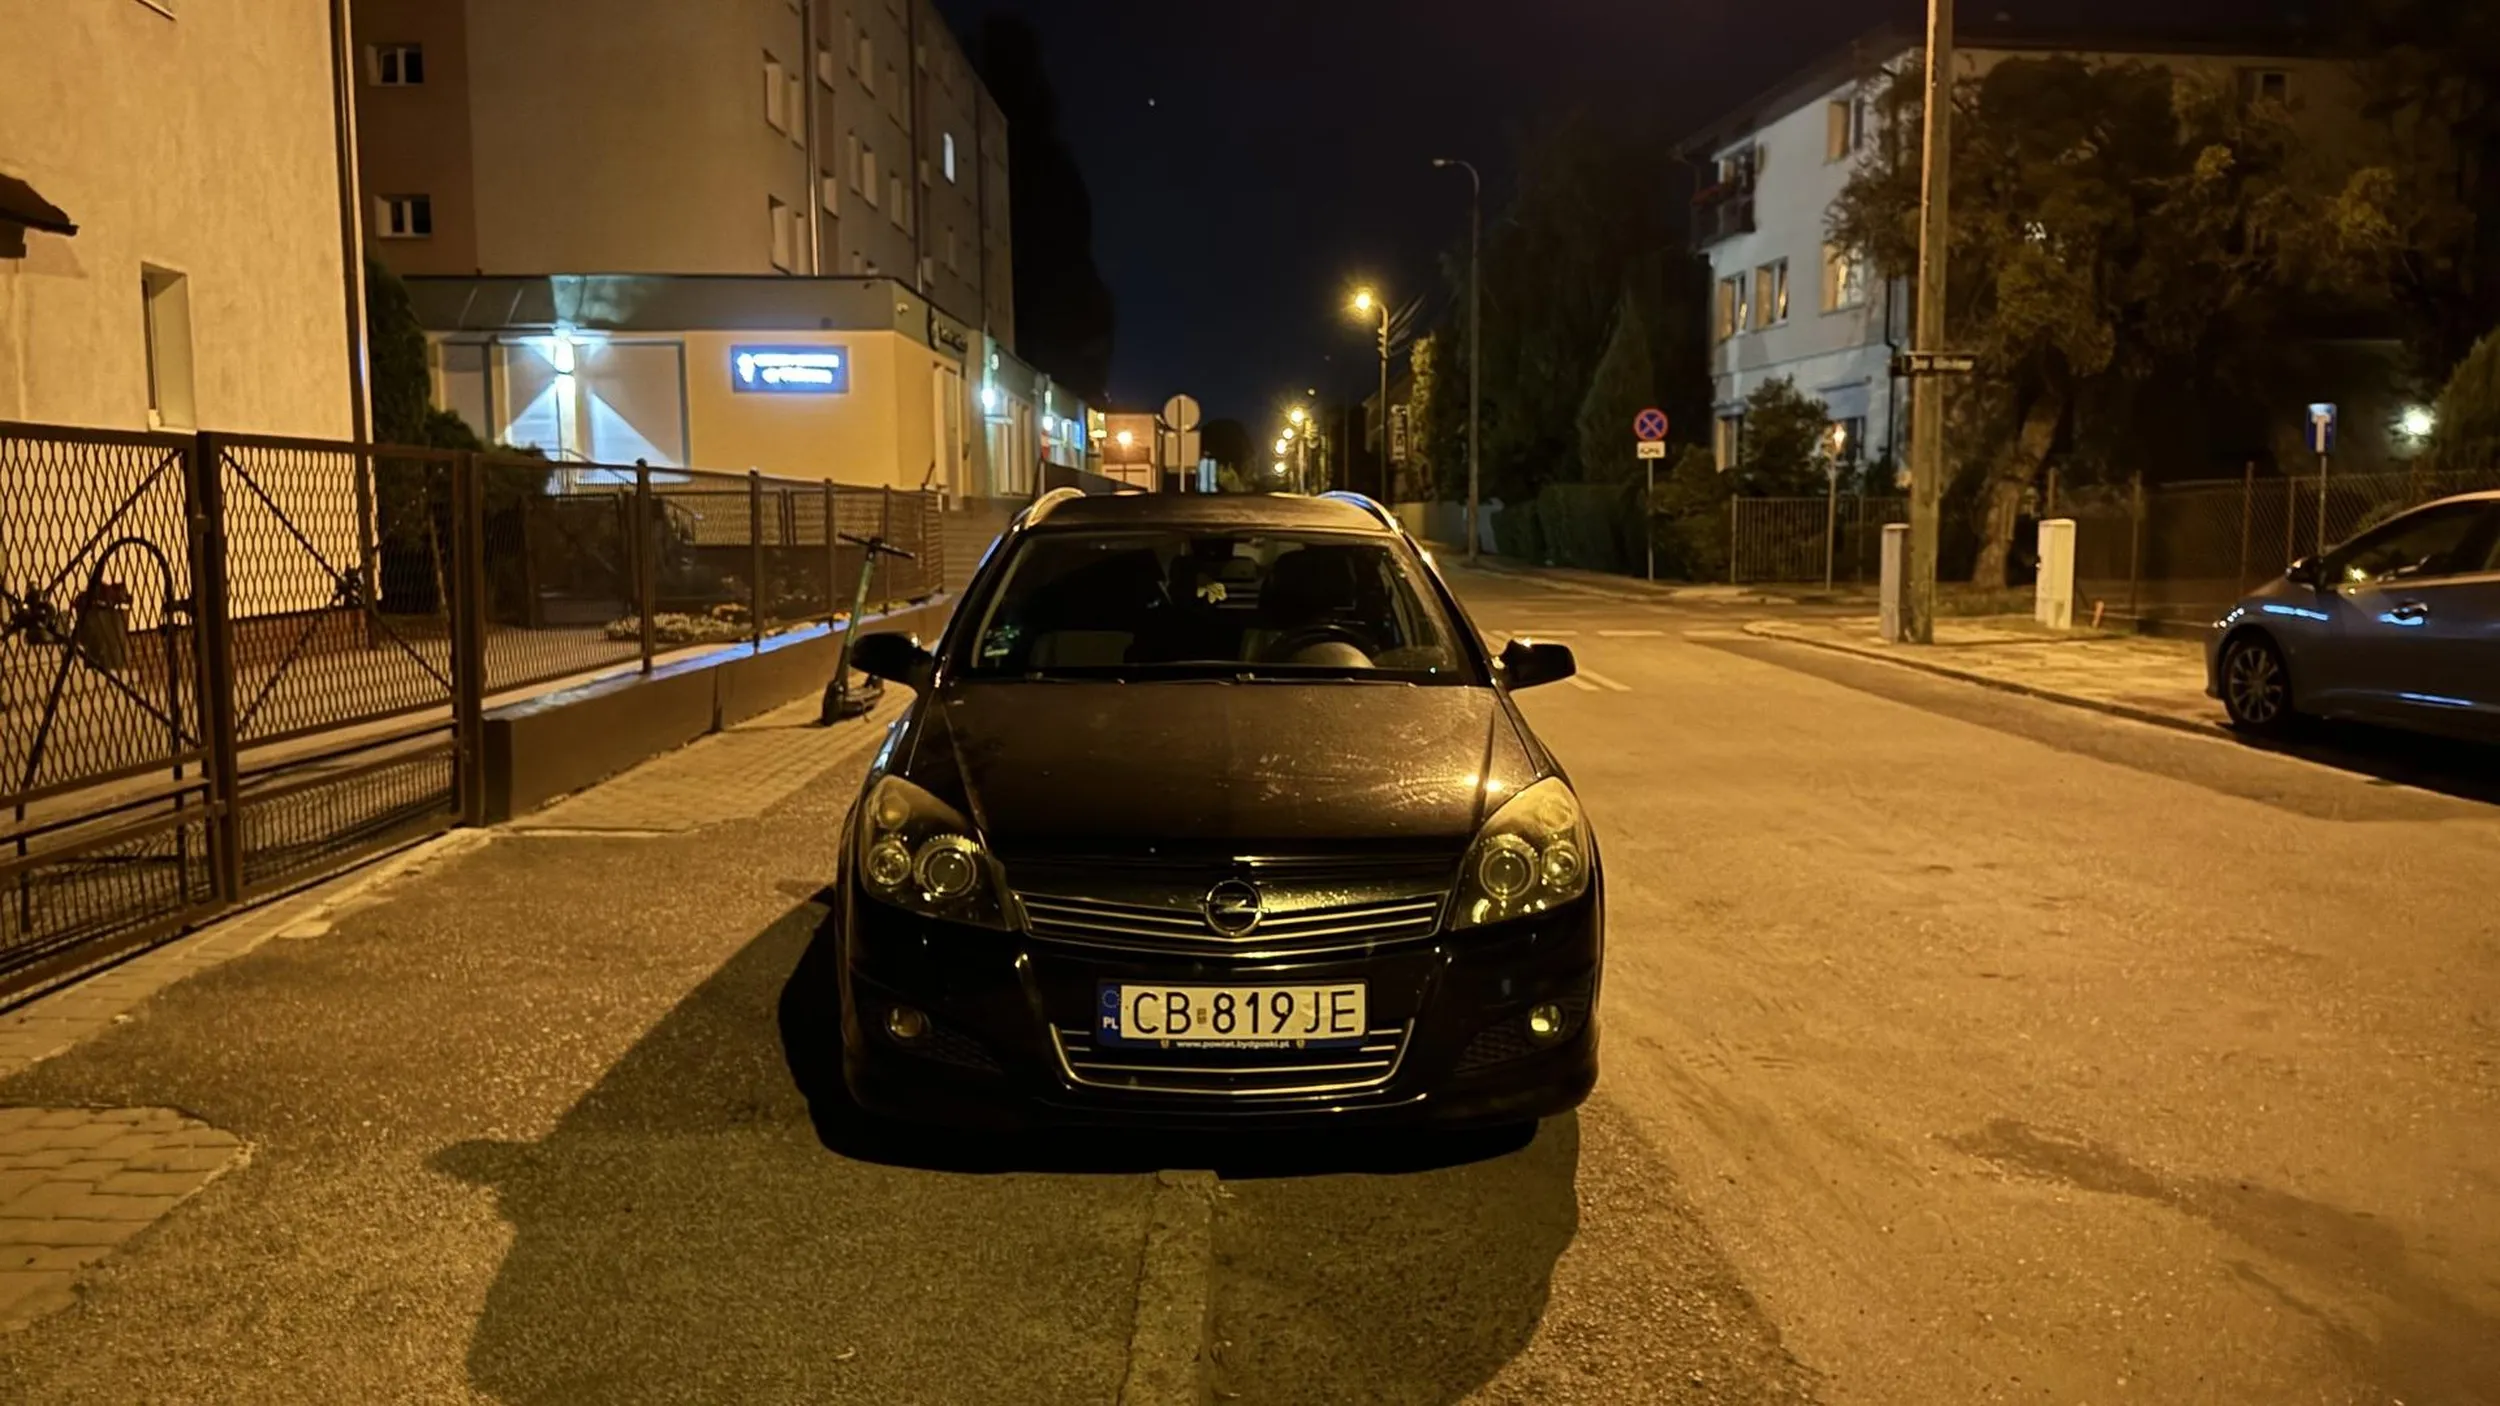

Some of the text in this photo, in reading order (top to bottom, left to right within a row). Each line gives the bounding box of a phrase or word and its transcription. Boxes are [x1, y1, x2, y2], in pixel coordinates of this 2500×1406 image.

[1103, 1016, 1119, 1030] PL
[1134, 991, 1355, 1034] CB 819JE
